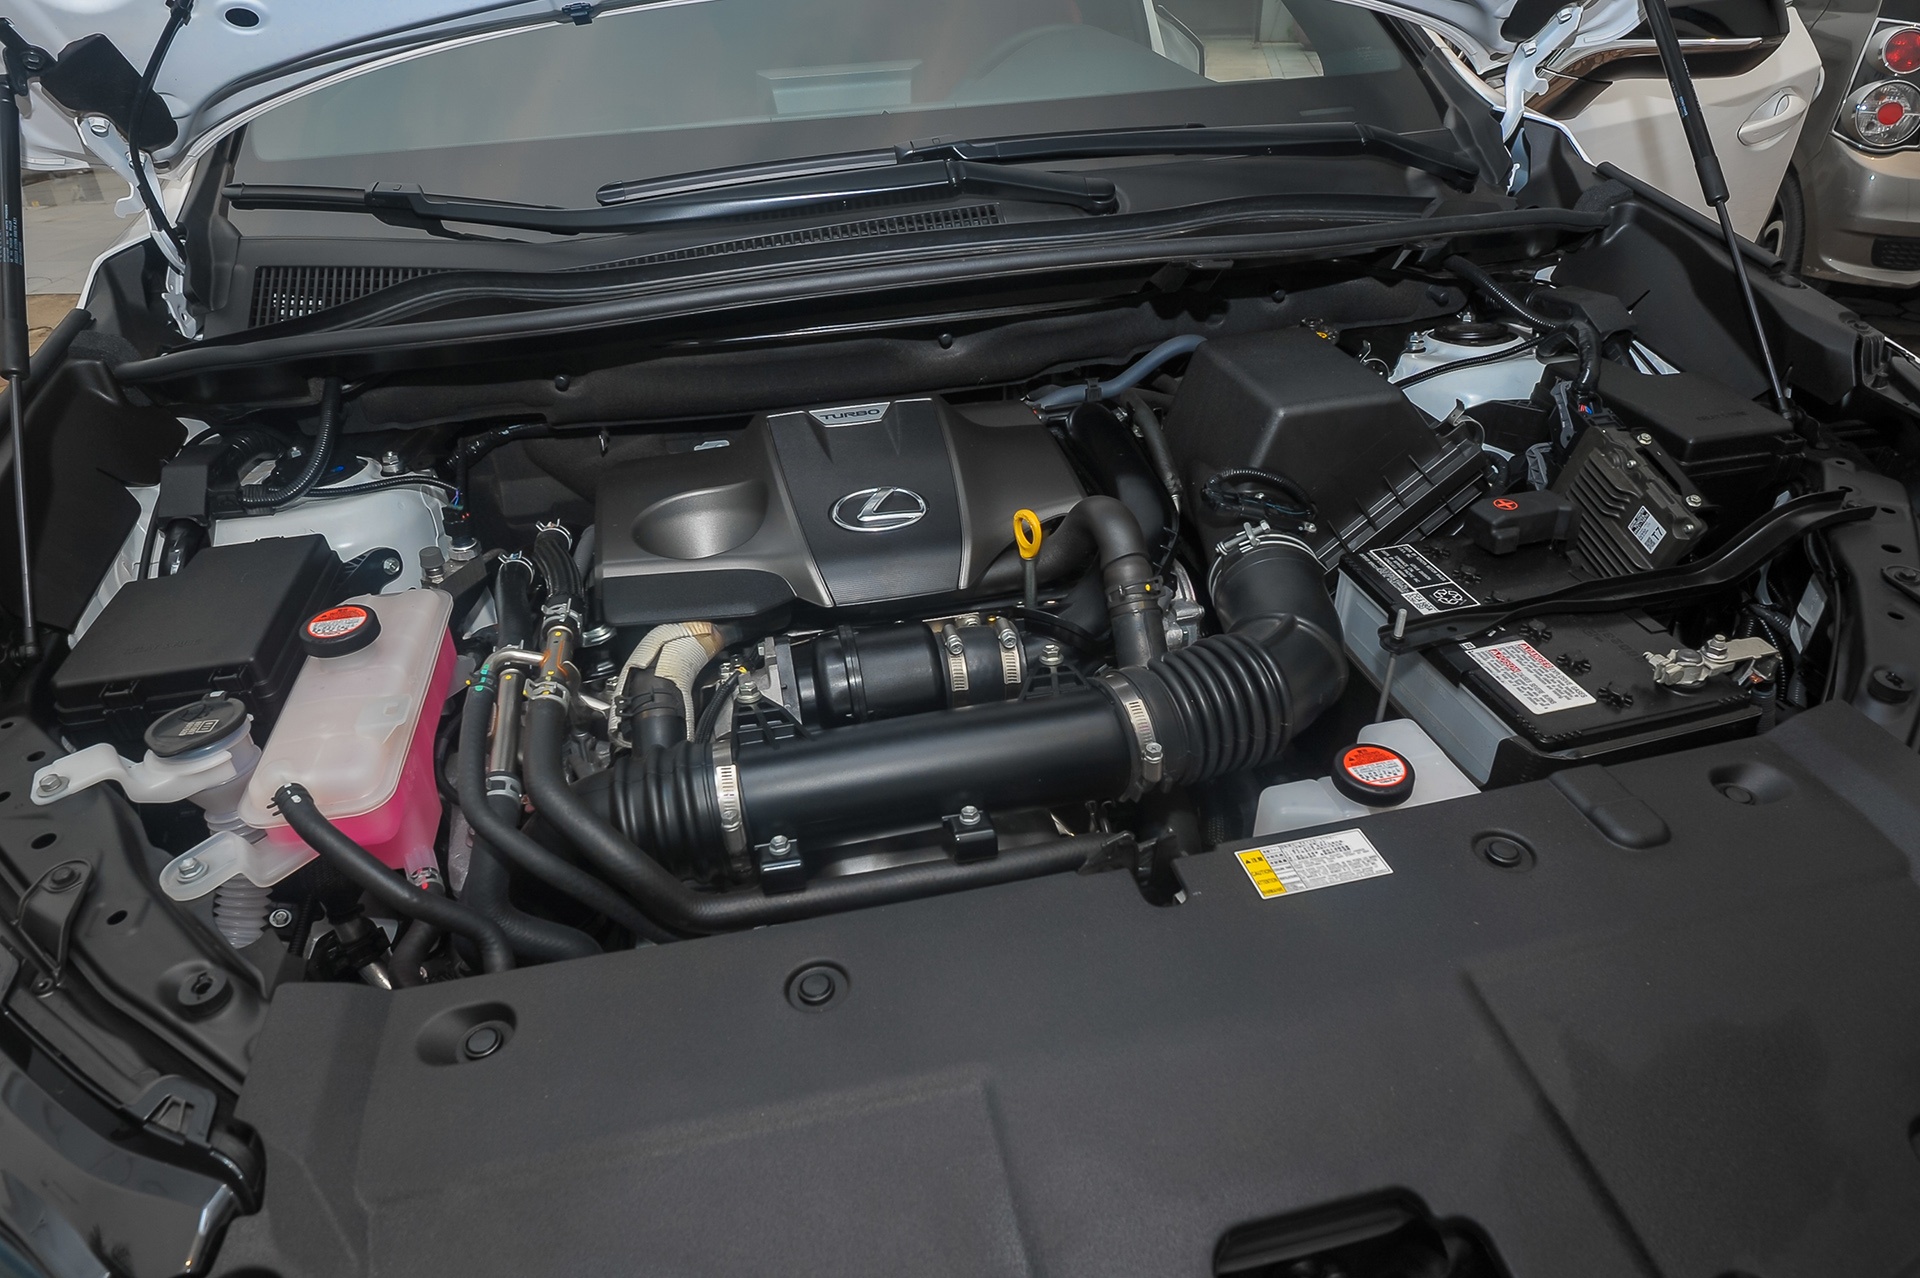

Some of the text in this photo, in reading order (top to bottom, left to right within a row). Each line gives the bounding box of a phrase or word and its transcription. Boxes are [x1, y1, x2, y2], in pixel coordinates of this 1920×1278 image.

[820, 408, 880, 420] TURBO
[1651, 527, 1662, 540] T7
[1496, 655, 1521, 673] POISON
[1526, 647, 1553, 668] DANGER
